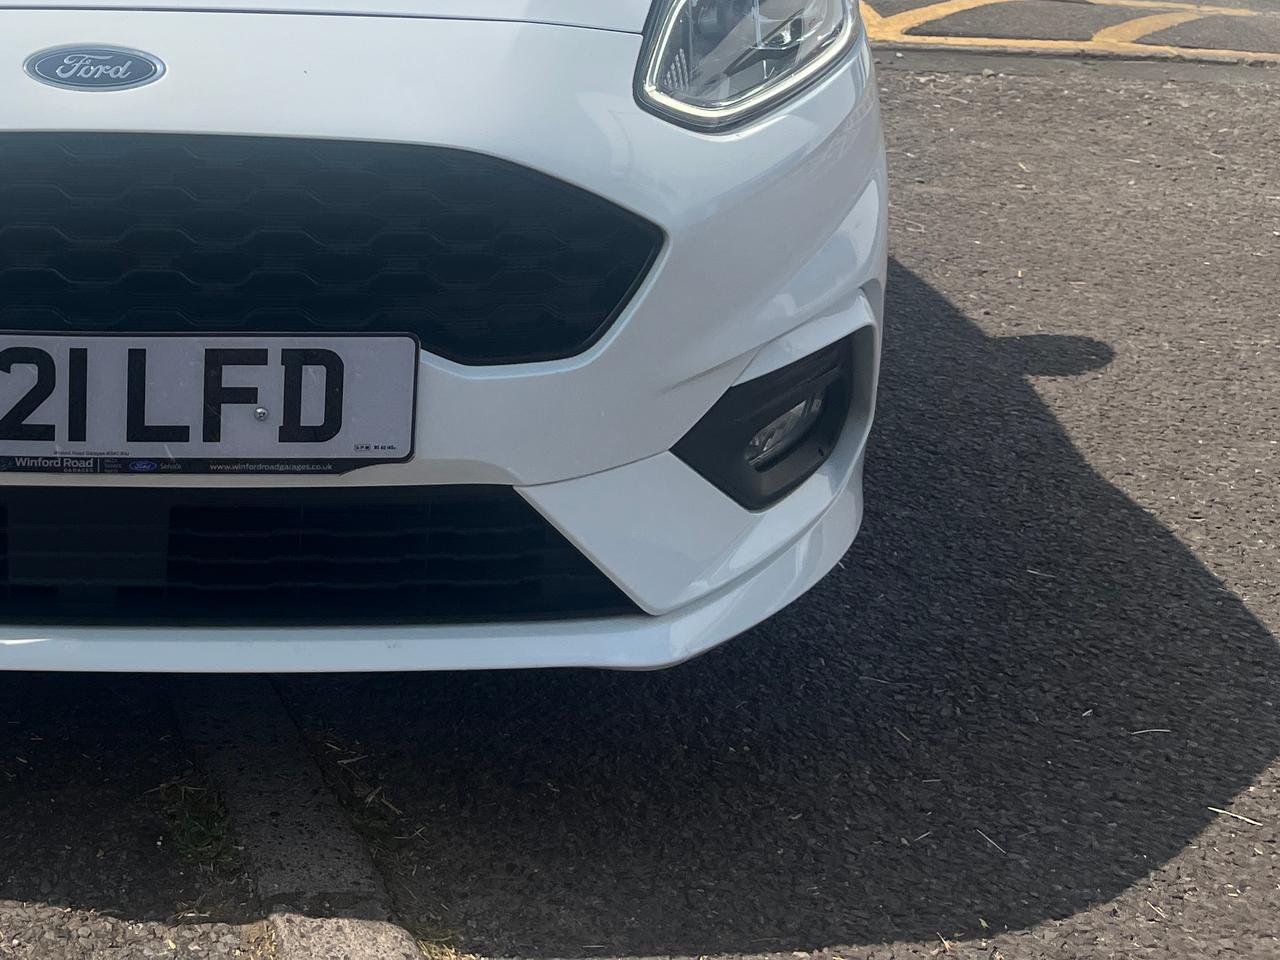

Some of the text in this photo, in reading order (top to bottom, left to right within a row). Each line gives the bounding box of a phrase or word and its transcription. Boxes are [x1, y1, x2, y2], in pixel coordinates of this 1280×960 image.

[55, 53, 132, 79] Ford
[126, 347, 345, 443] LFD
[15, 457, 61, 468] Winford
[63, 457, 94, 468] Road
[209, 461, 333, 472] www.winfordroadgarages.co.uk
